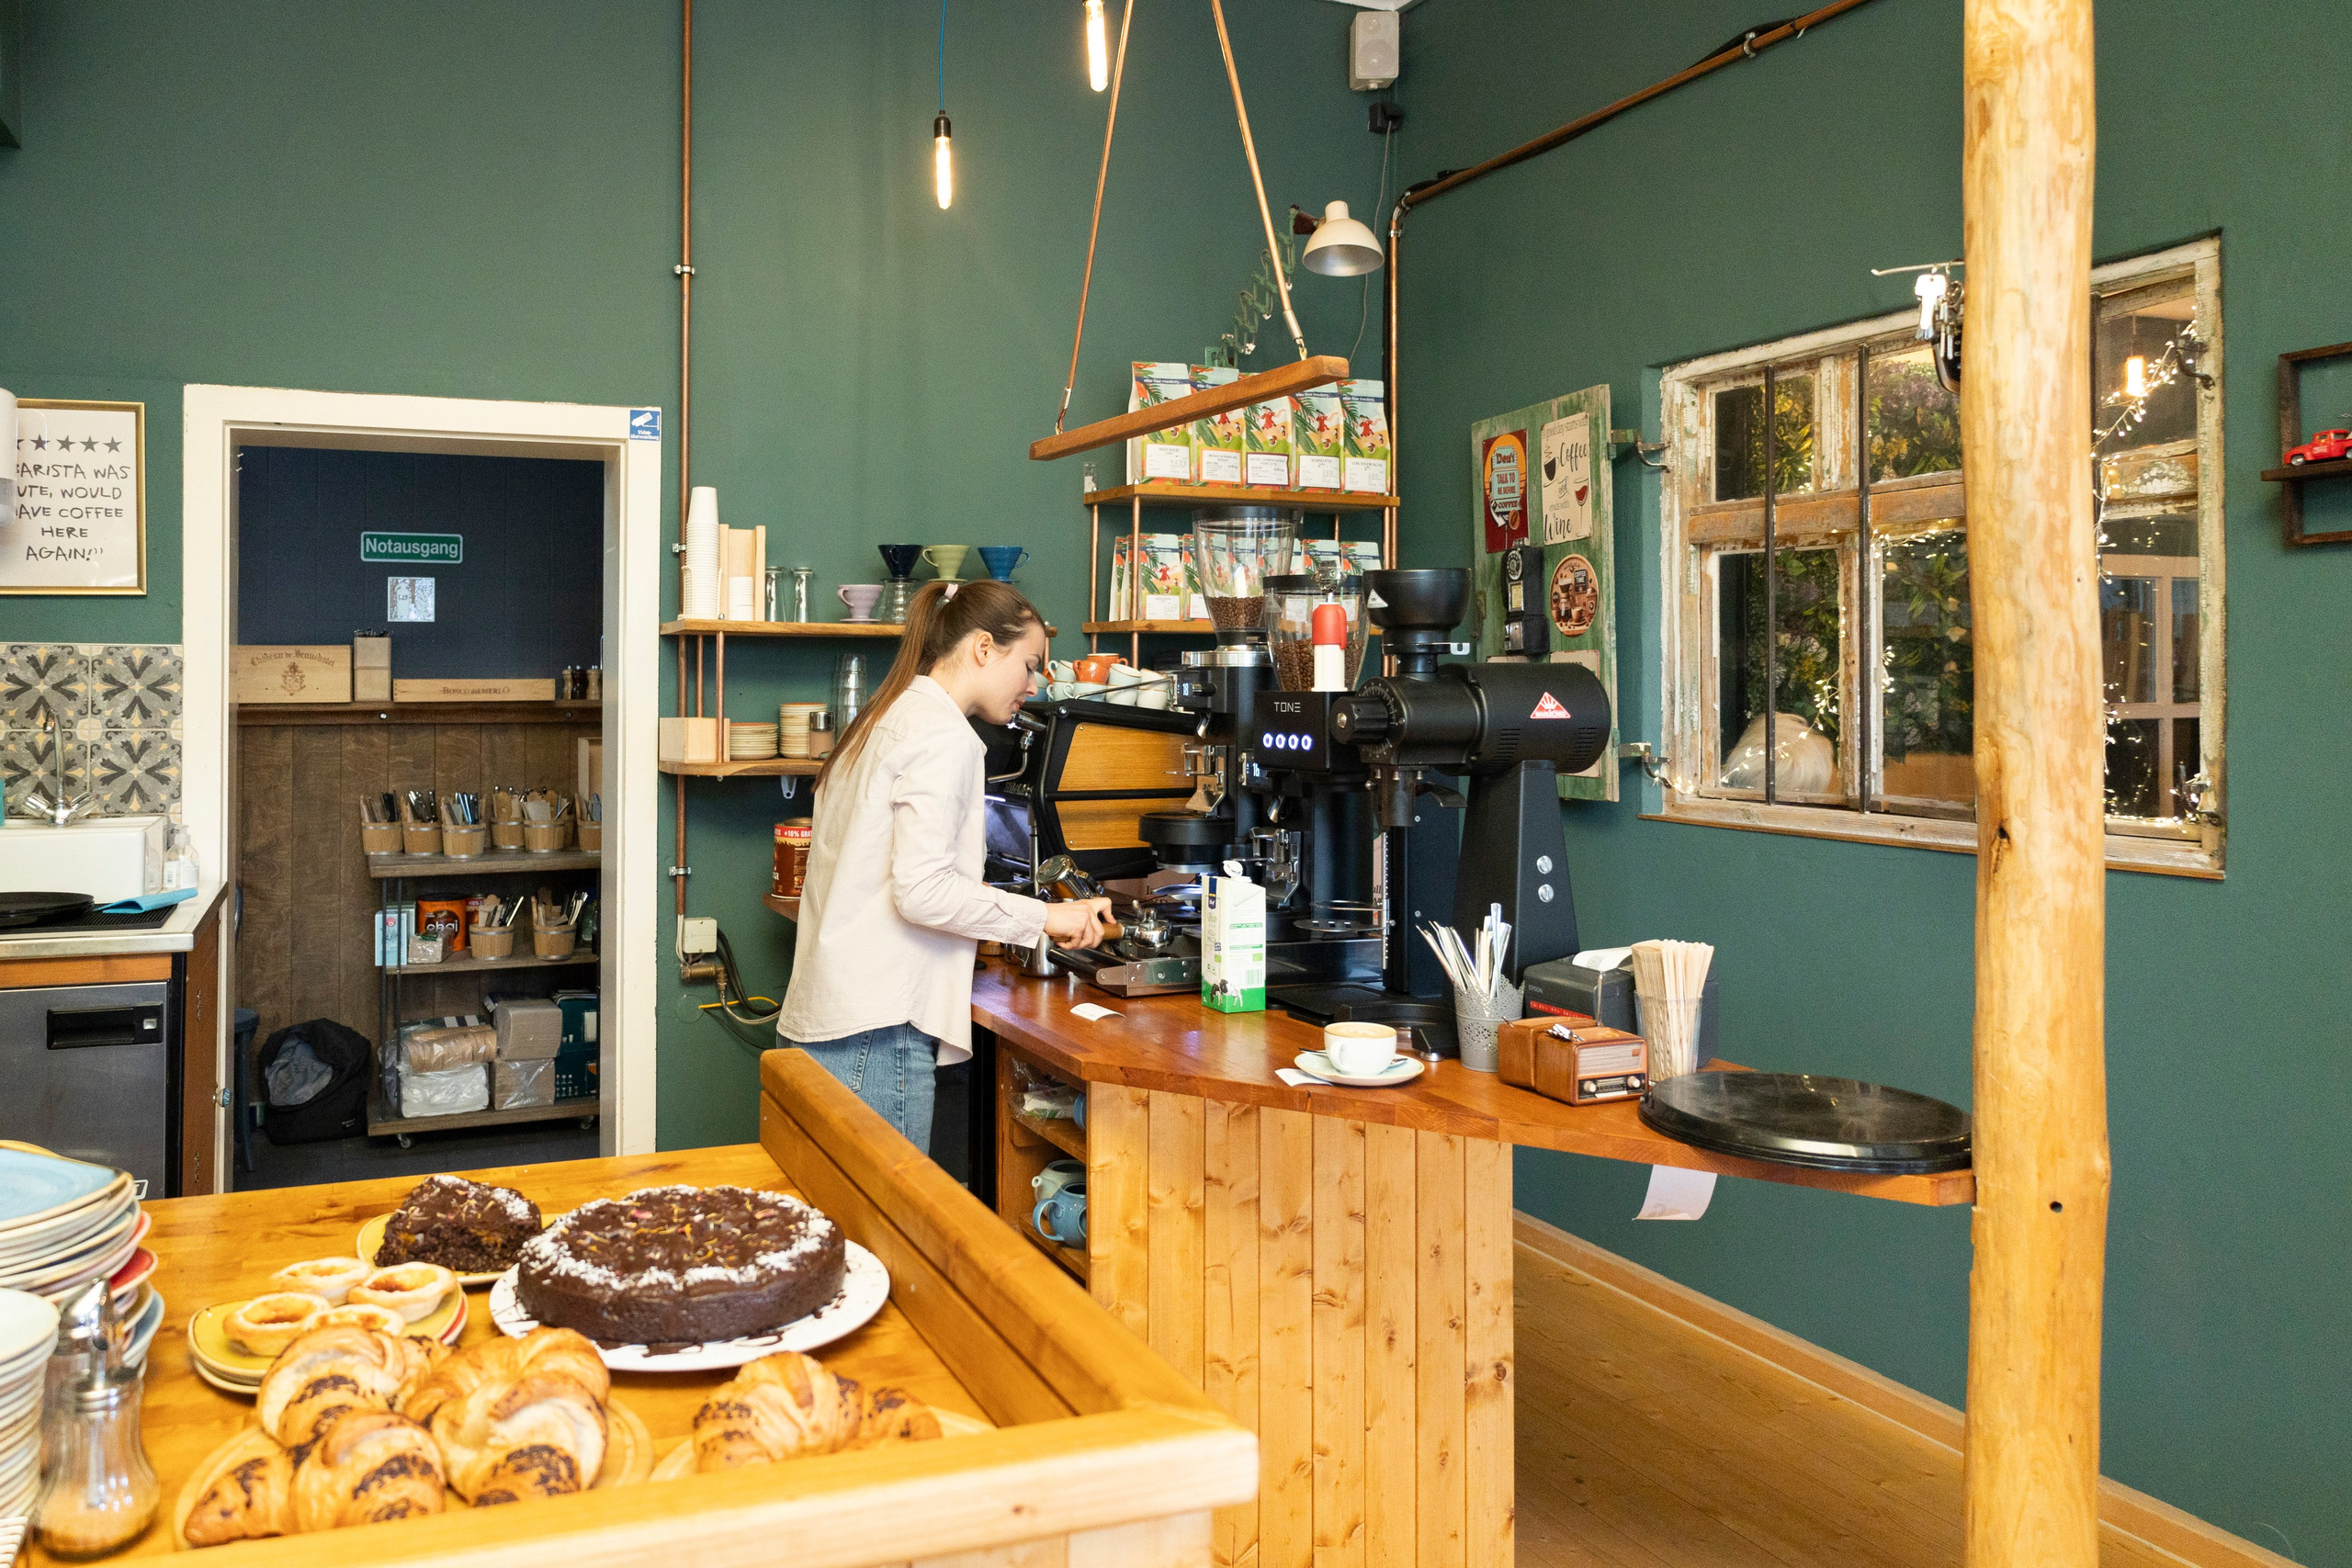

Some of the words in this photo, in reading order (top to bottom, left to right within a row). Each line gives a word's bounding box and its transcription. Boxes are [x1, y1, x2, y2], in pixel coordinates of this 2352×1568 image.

[1496, 451, 1516, 465] Don't
[1560, 443, 1588, 472] Coffee
[94, 464, 130, 479] WAS
[1497, 472, 1508, 484] TALK
[1509, 472, 1515, 483] TO
[17, 485, 52, 498] UTE,
[61, 487, 122, 500] WOULD
[1503, 486, 1516, 495] BEFORE
[16, 504, 51, 520] AVE
[59, 507, 123, 519] COFFEE
[1498, 501, 1518, 509] COFFEE
[41, 526, 88, 538] HERE
[1544, 513, 1572, 543] Wine
[365, 537, 458, 558] Notausgang
[1274, 702, 1301, 713] TONE
